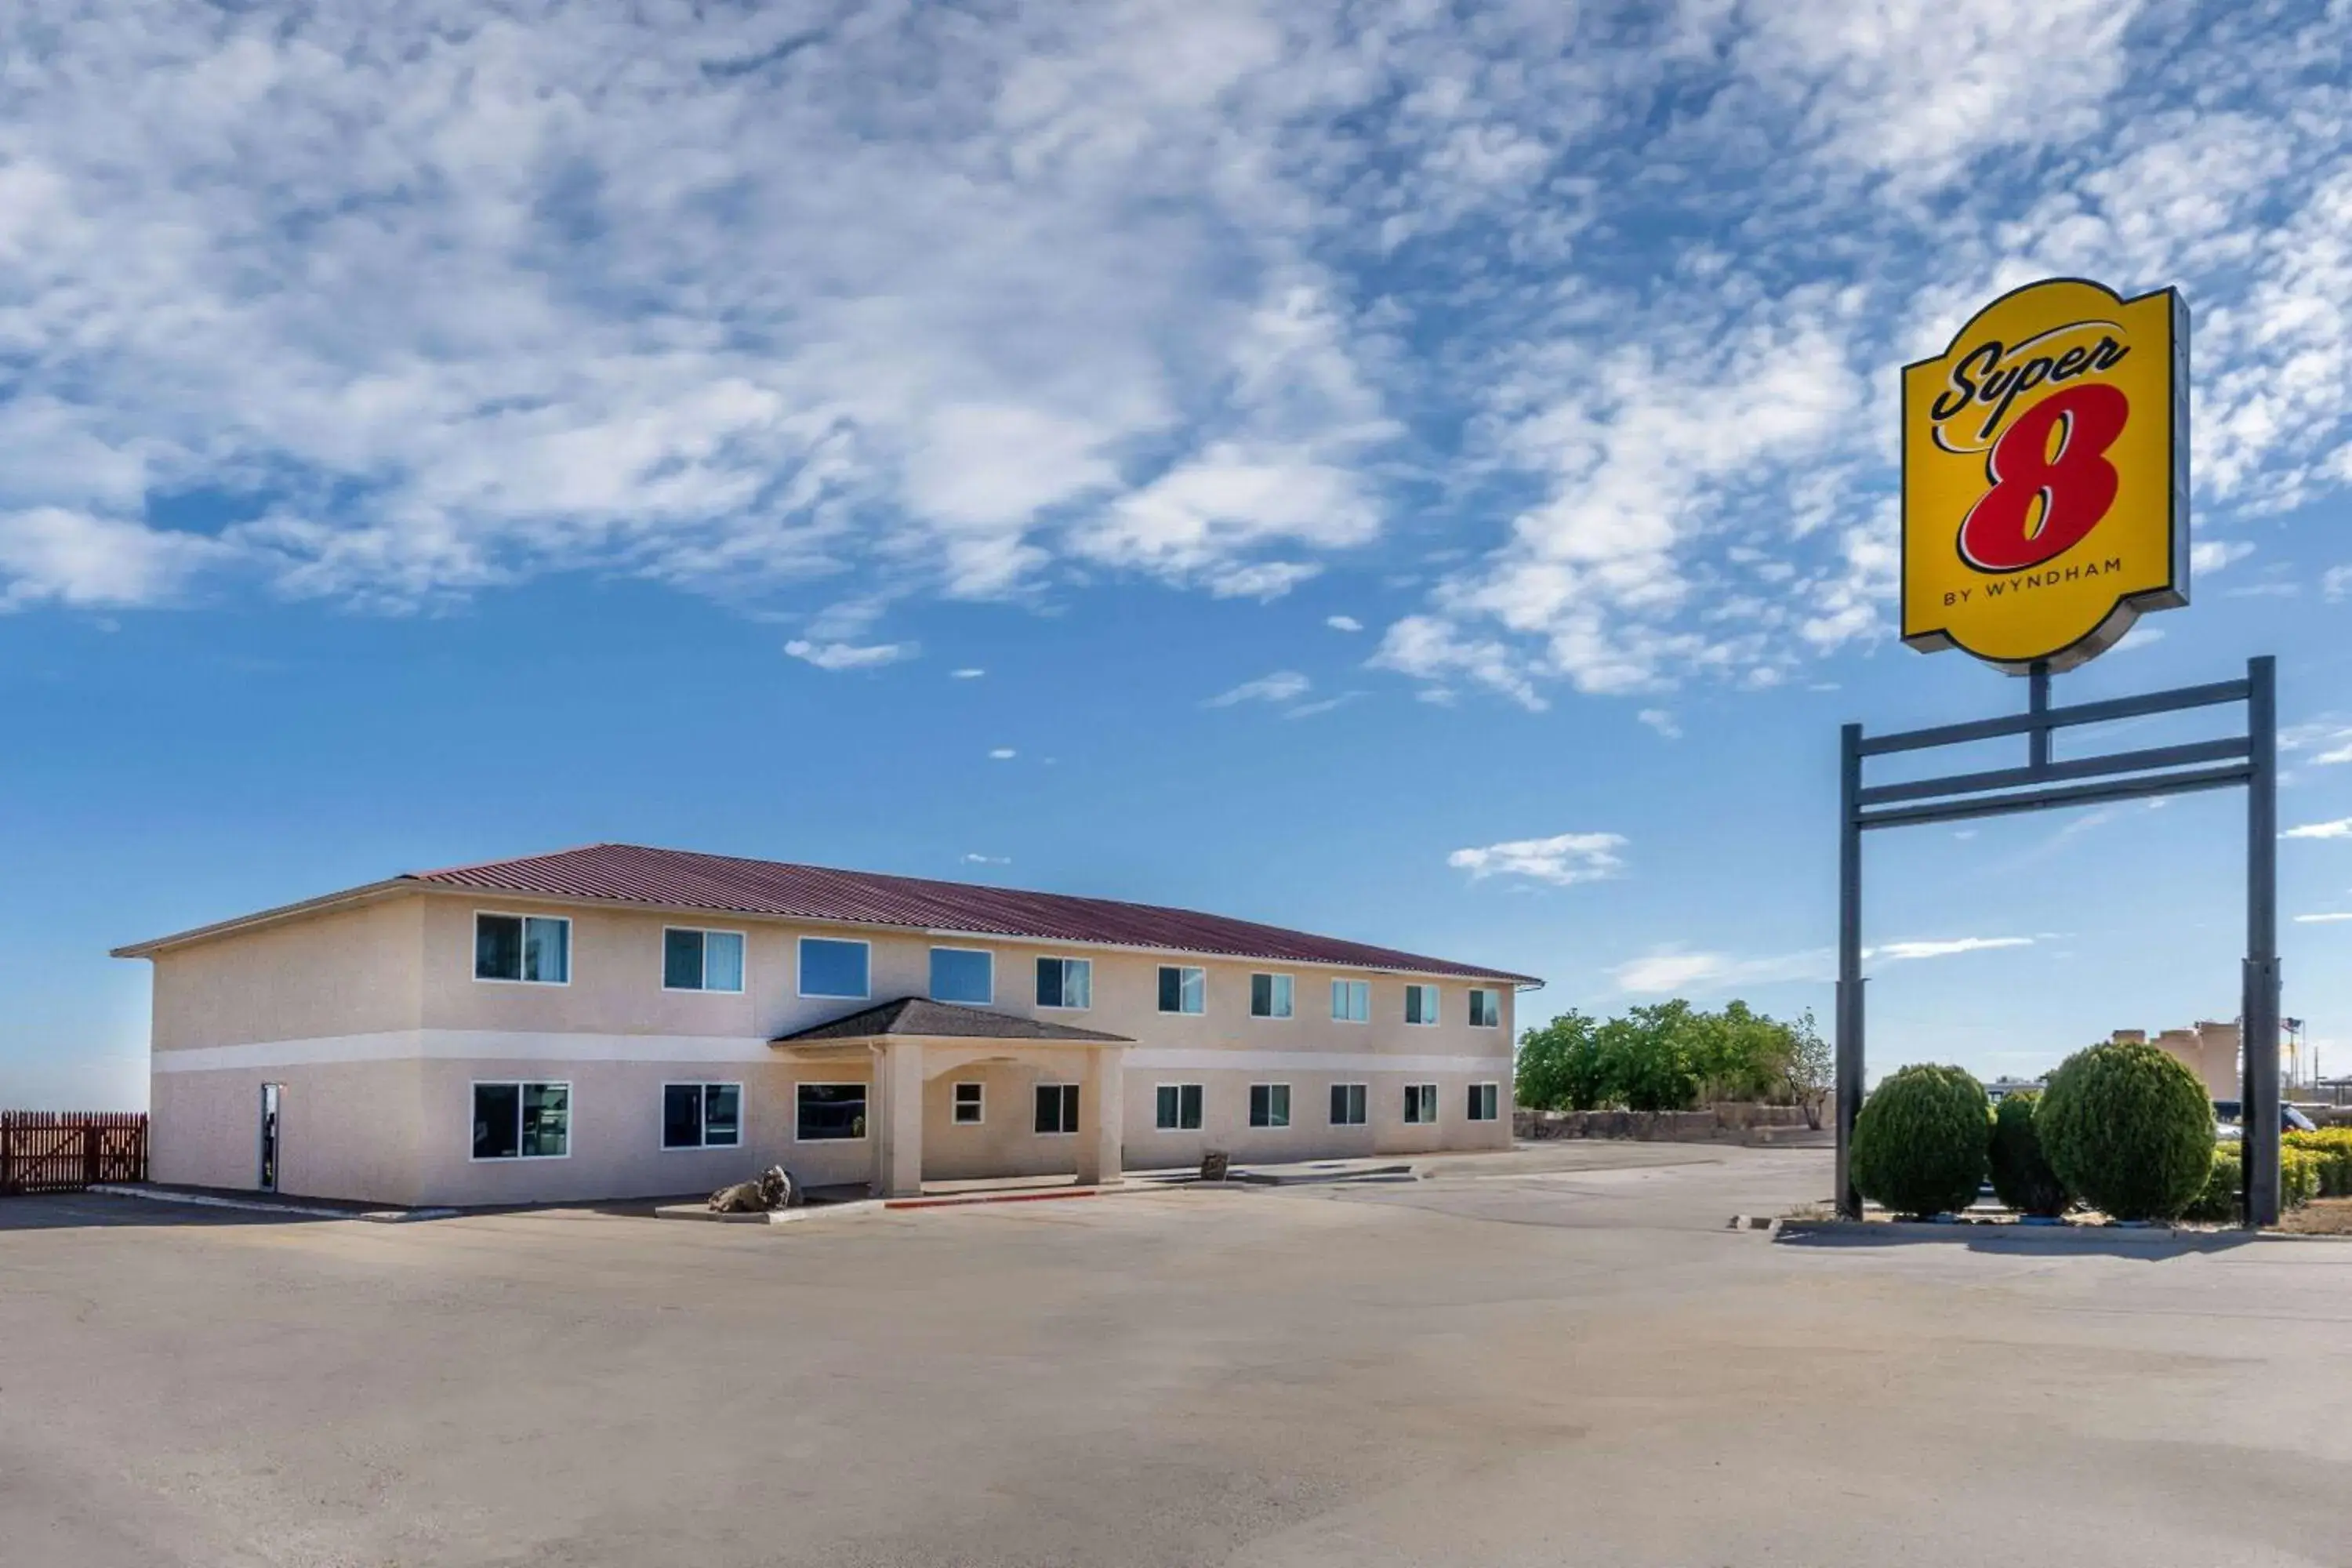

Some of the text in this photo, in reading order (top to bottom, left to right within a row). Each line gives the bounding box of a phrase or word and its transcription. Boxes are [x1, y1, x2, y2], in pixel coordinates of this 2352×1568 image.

[1931, 336, 2131, 440] Super
[1956, 383, 2129, 575] 8
[1944, 557, 2122, 606] BY WYNDHAM
